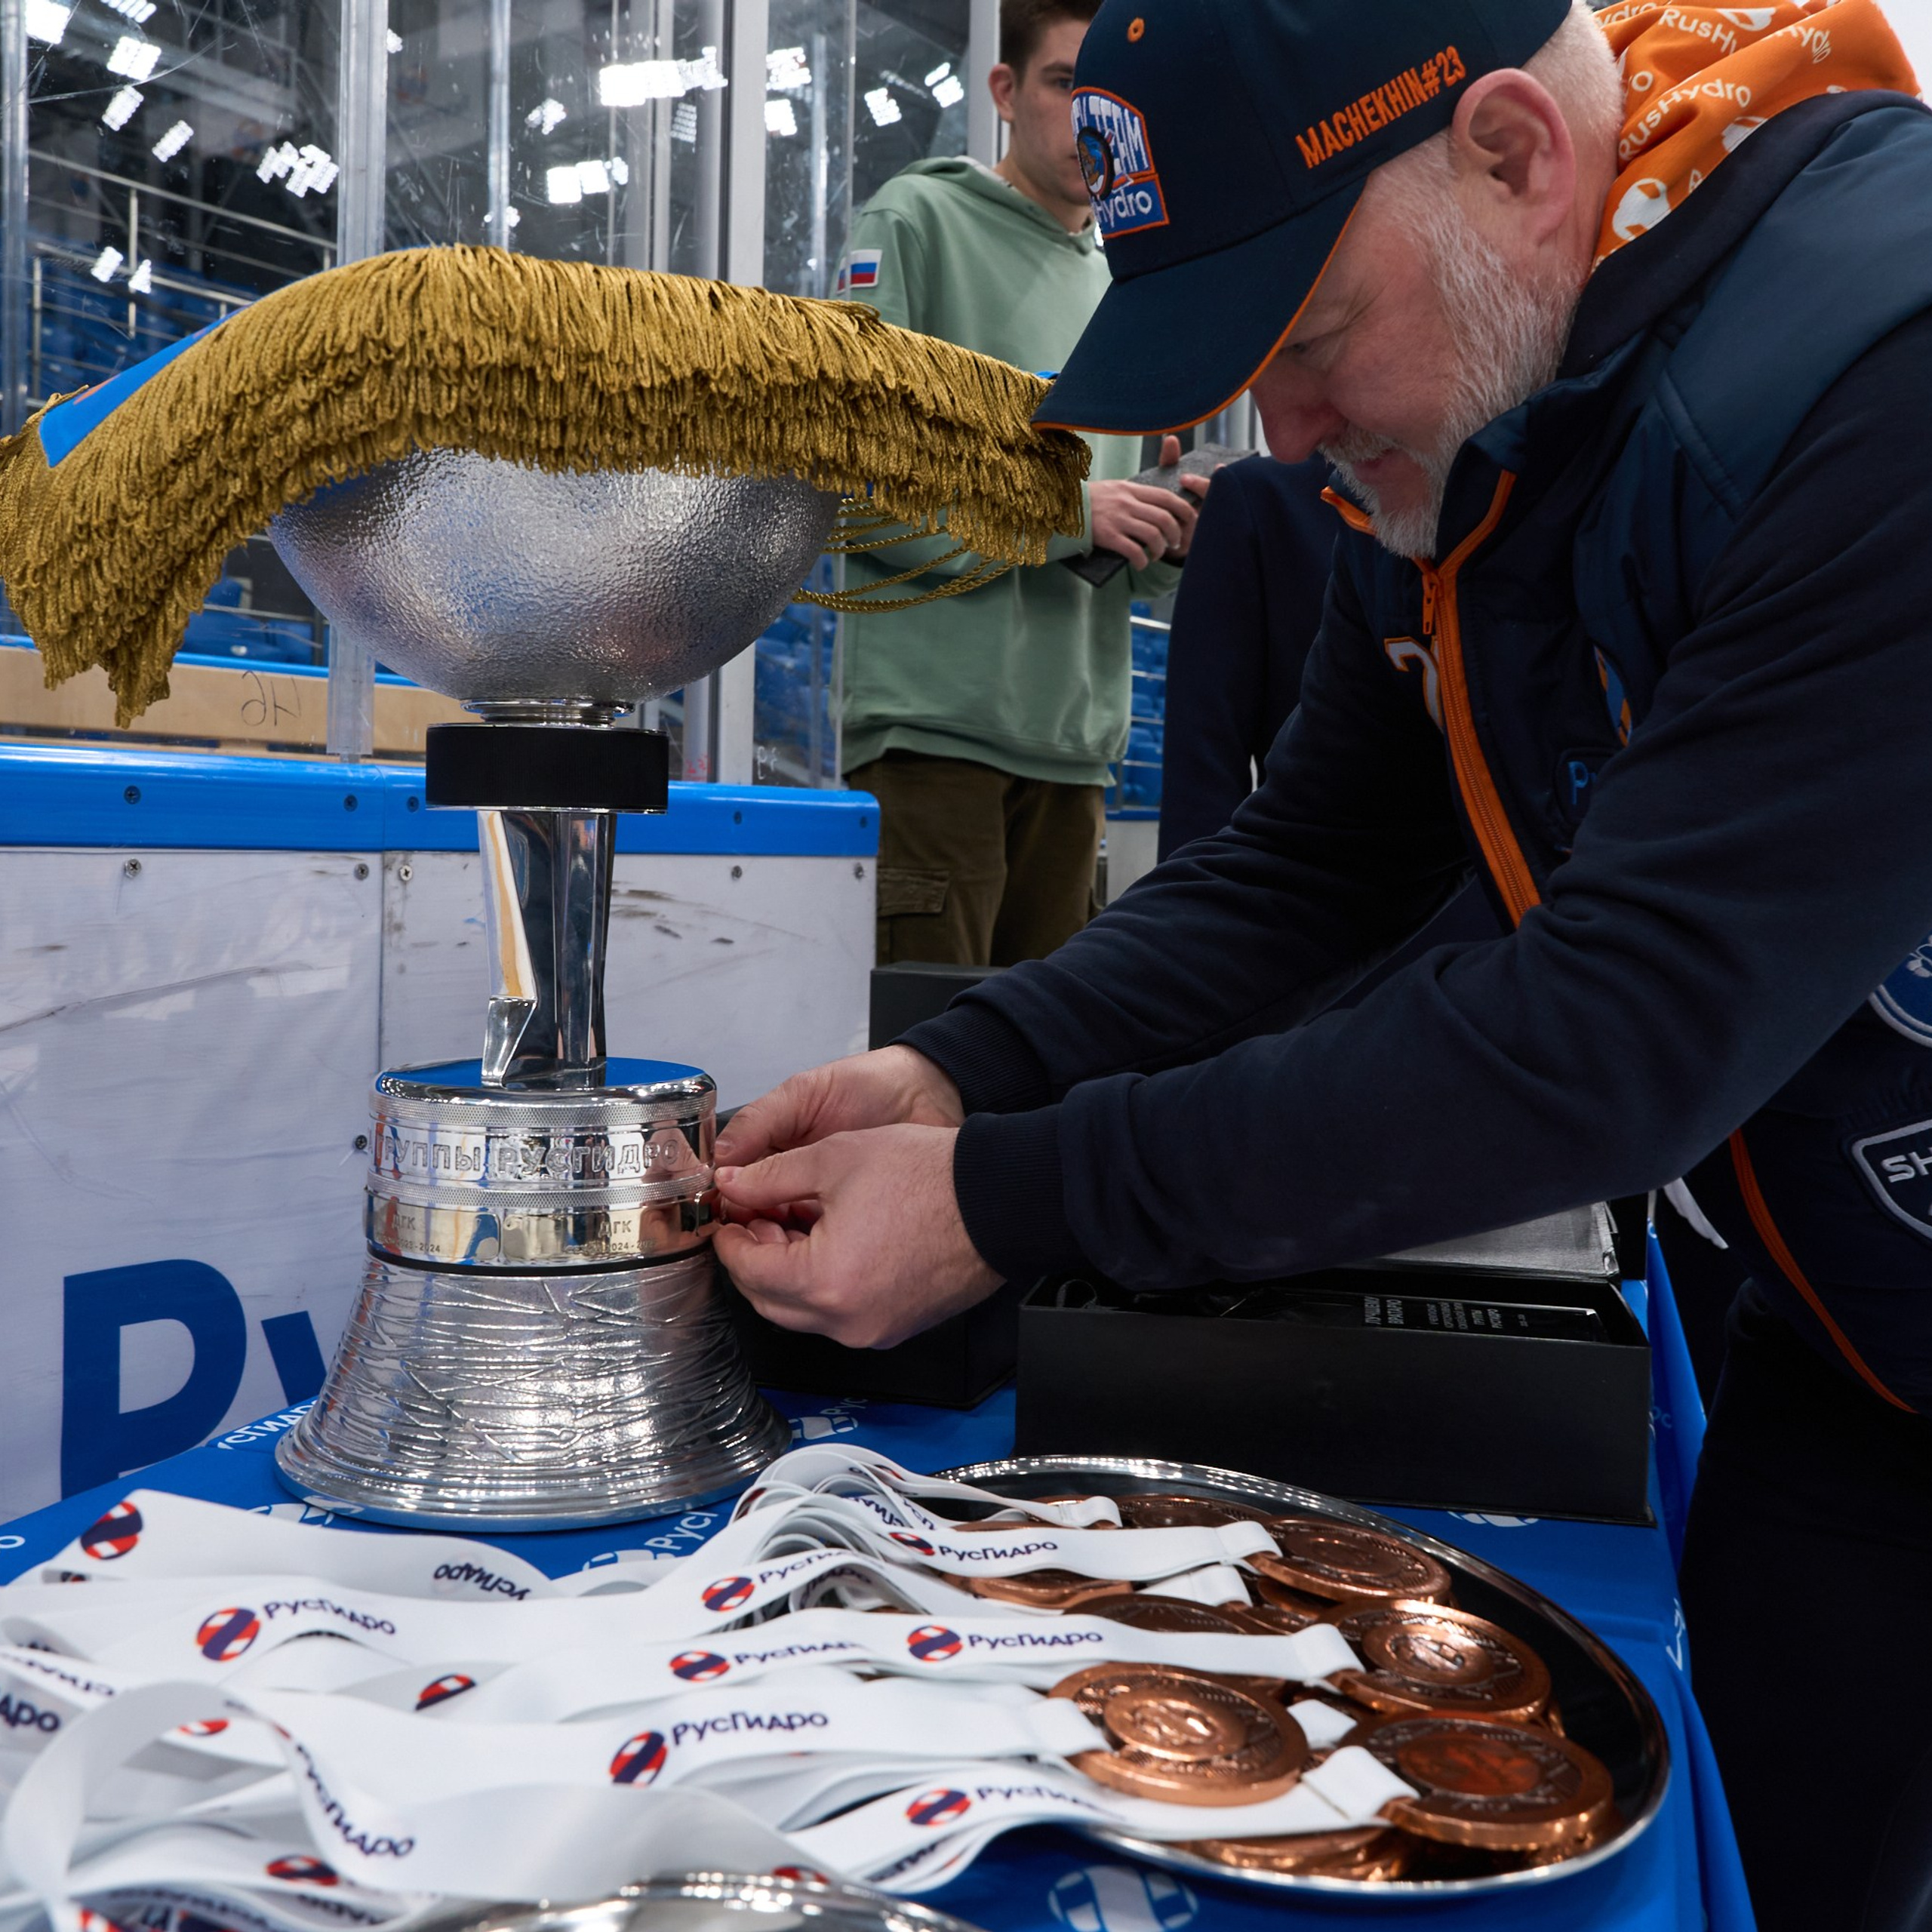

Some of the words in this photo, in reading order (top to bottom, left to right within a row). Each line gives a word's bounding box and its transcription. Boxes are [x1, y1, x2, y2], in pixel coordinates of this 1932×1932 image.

[1295, 45, 1466, 169] MACHEKHIN#23
[1619, 78, 1751, 161] RusHydro
[498, 1139, 679, 1174] РУСГИДРО
[938, 1541, 1058, 1562] РусГидро
[433, 1563, 531, 1601] усГидро
[264, 1598, 396, 1635] РусГидро
[968, 1631, 1103, 1651] РусГидро
[672, 1711, 829, 1746] РусГидро
